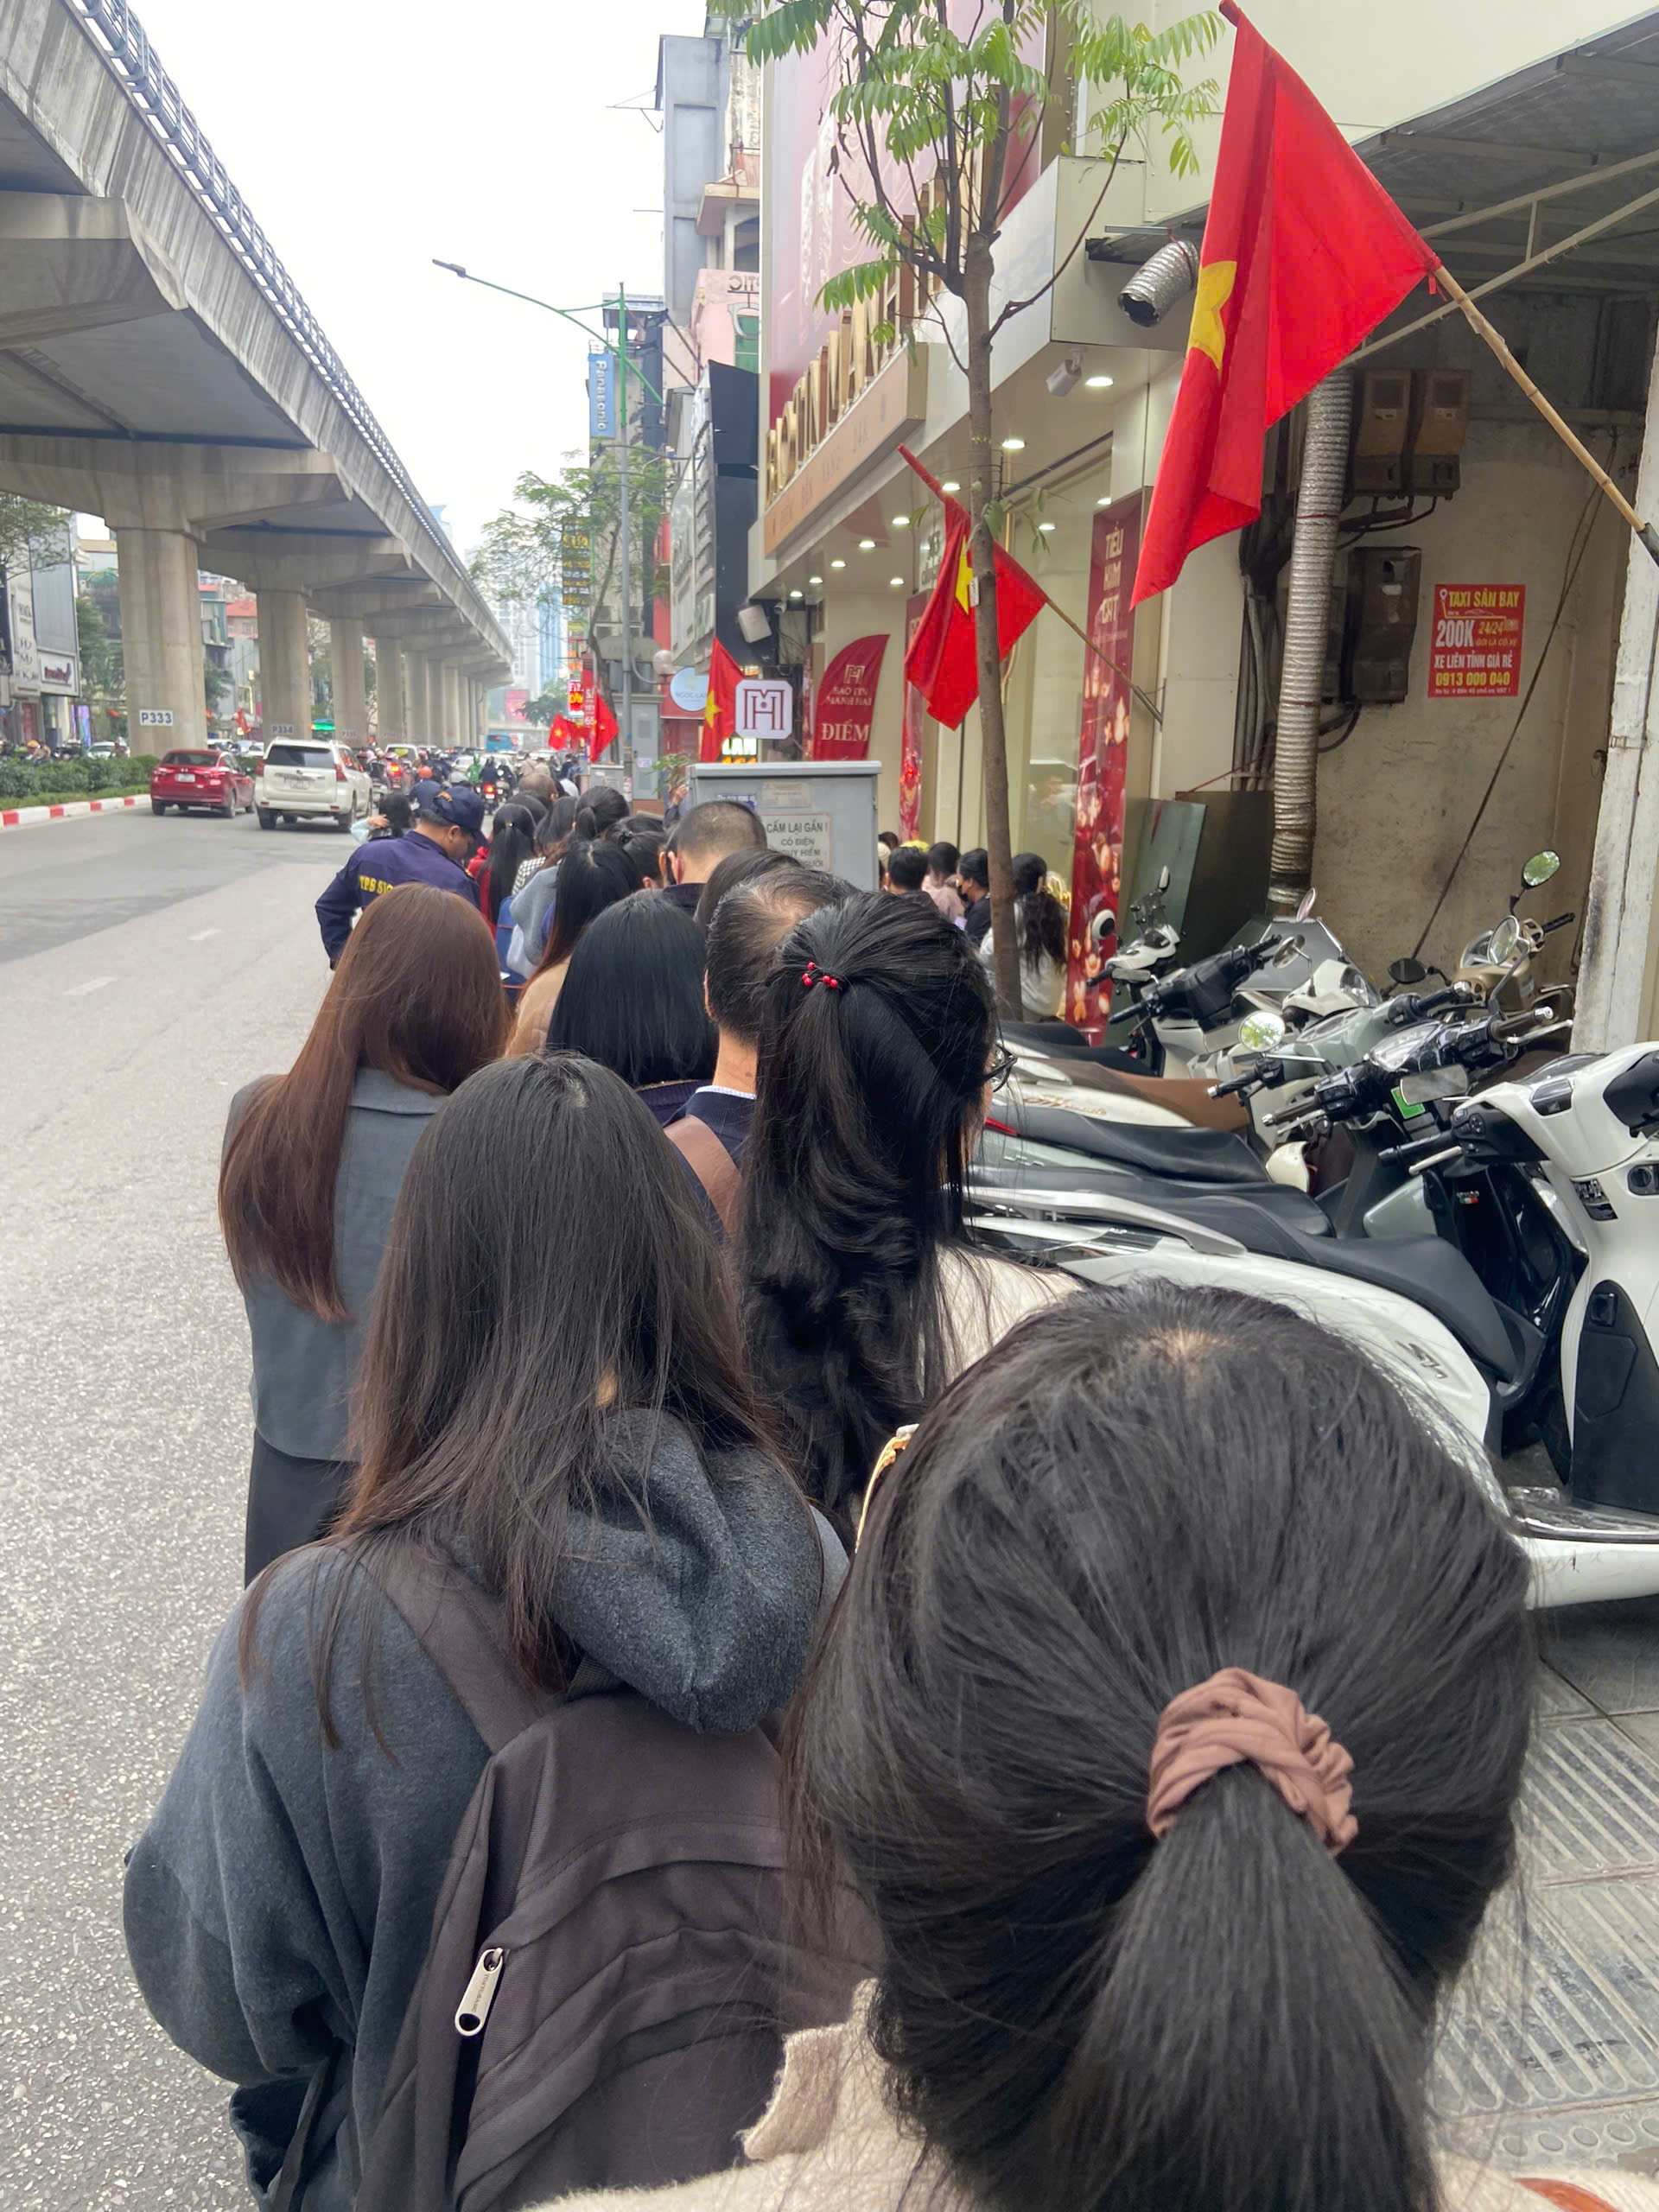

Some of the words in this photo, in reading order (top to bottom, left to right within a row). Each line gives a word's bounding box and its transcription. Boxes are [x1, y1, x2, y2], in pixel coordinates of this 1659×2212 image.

[595, 360, 607, 429] Panasonic
[1448, 590, 1471, 607] TAXI
[1473, 588, 1497, 607] SÂN
[1499, 590, 1520, 607] BAY
[1435, 620, 1476, 648] 200K
[1434, 654, 1445, 669] XE
[1446, 651, 1465, 669] LIÊN
[1487, 651, 1500, 668] GIÁ
[1435, 672, 1463, 686] 0913
[1466, 671, 1486, 686] 000
[1490, 671, 1510, 686] 040
[142, 712, 172, 724] P333
[821, 718, 871, 741] ĐIỂM
[766, 820, 785, 833] CẤM
[788, 823, 802, 835] LẠI
[781, 836, 793, 846] CÓ
